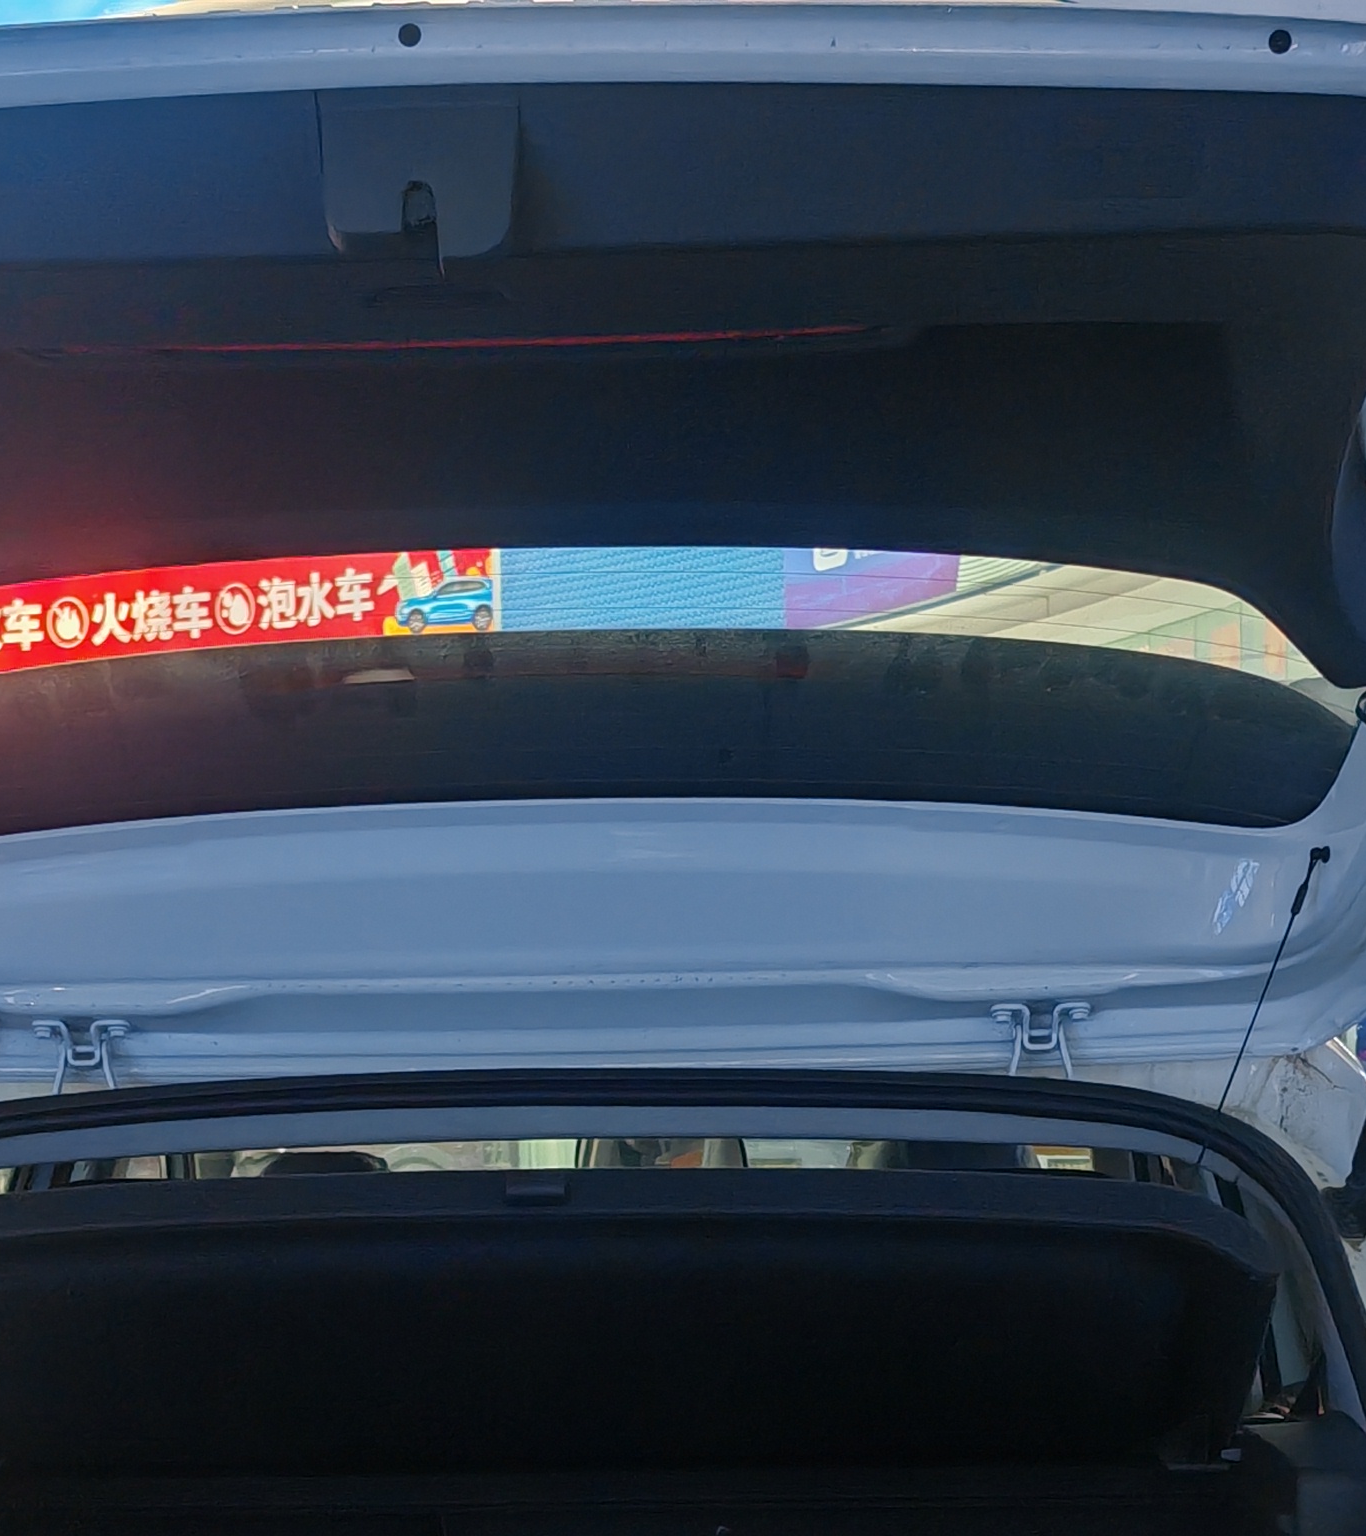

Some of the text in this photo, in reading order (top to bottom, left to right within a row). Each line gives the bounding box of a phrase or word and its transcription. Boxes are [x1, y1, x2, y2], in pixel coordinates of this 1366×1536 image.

[91, 586, 214, 647] 火烧车
[257, 567, 375, 630] 泡水车
